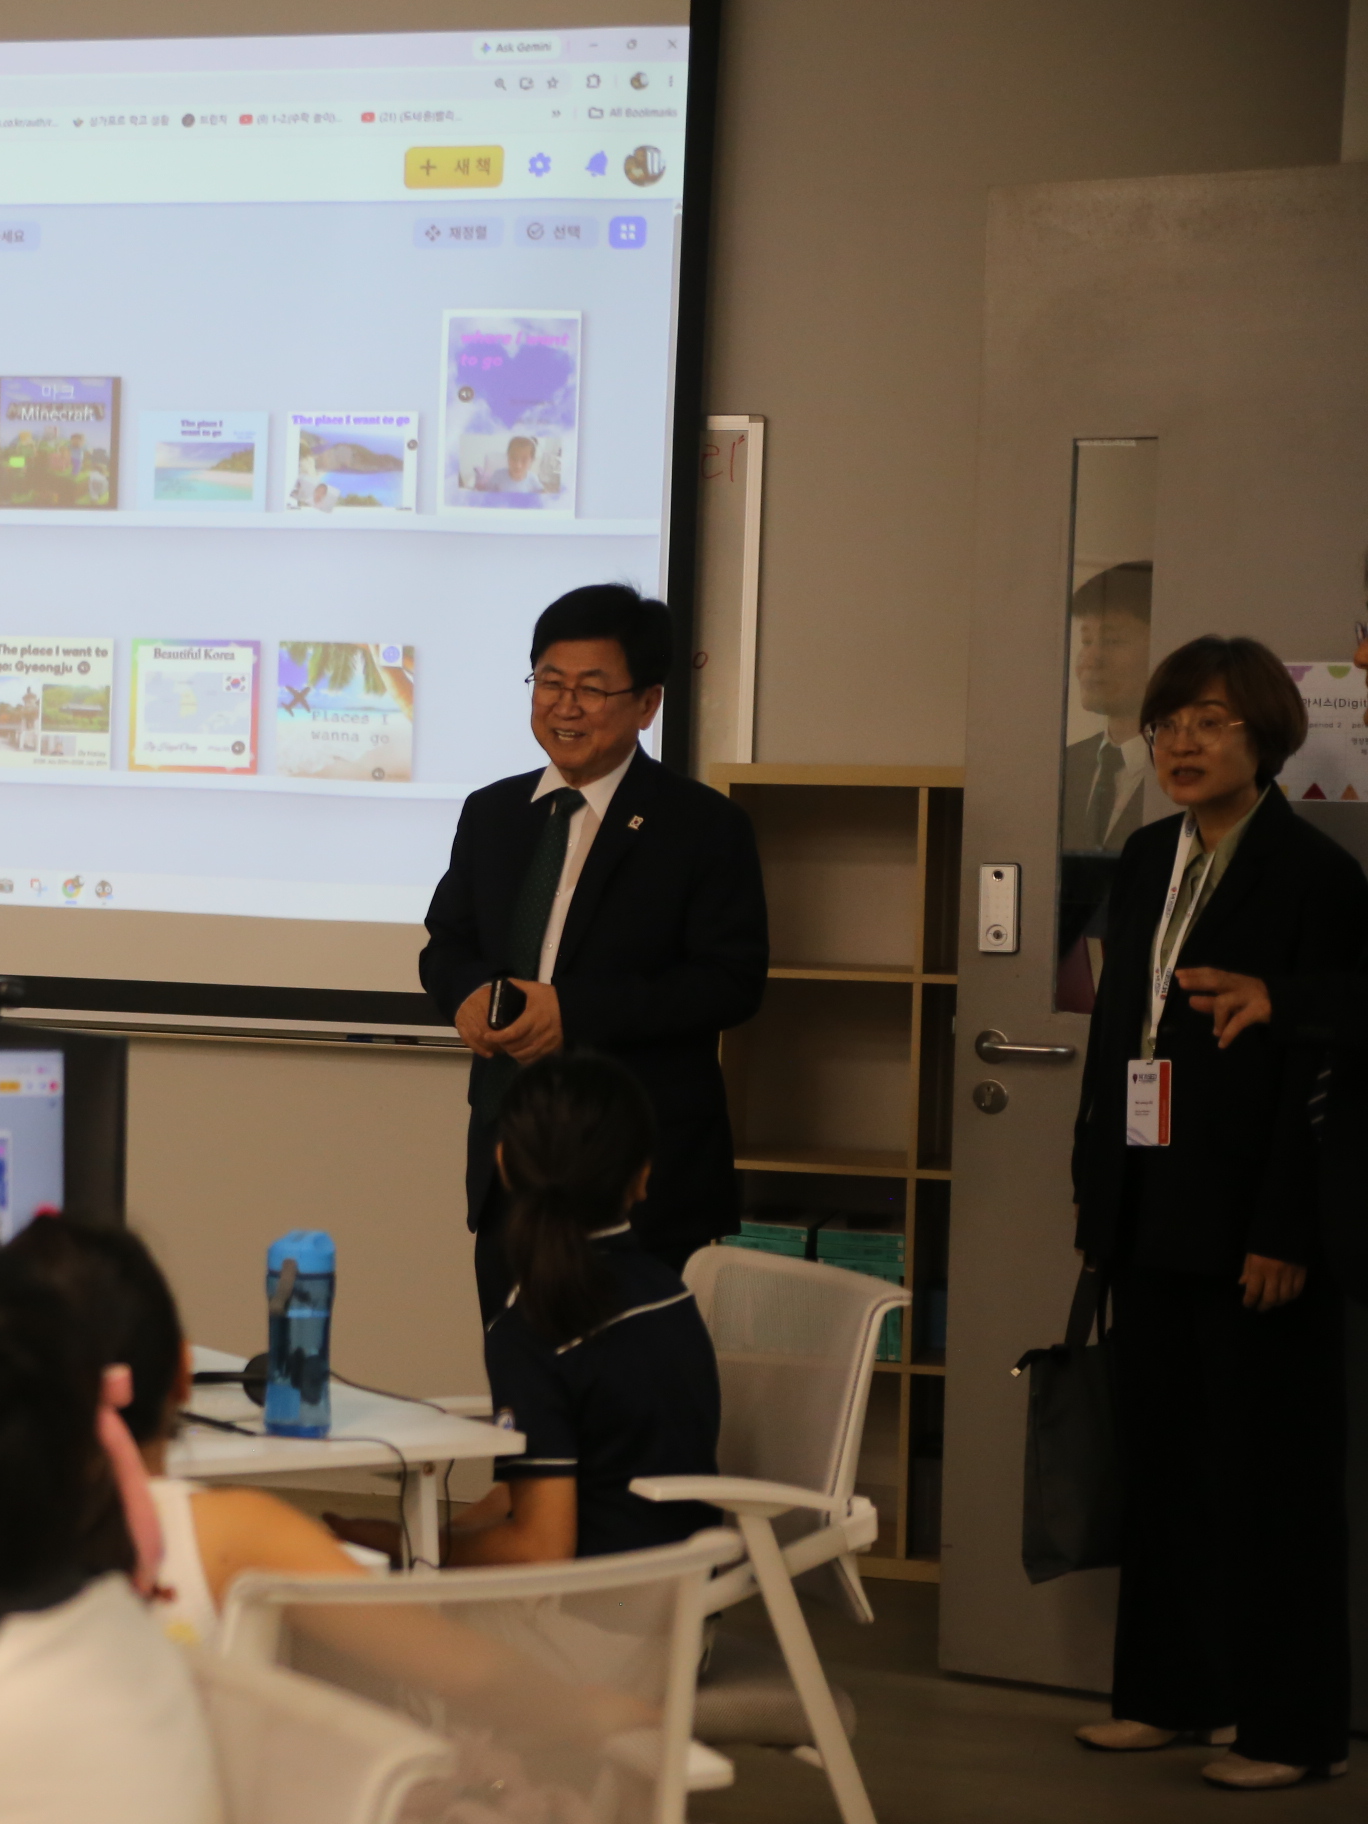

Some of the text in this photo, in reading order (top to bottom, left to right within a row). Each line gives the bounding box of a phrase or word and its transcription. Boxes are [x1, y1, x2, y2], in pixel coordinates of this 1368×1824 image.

[496, 41, 552, 53] Ask Gemini
[625, 106, 678, 119] Bookmarks
[454, 156, 492, 177] 새 책
[449, 223, 489, 242] 재정렬
[553, 223, 582, 241] 선택
[460, 352, 504, 372] to go
[20, 405, 95, 422] Minecraft
[291, 414, 314, 426] The
[314, 414, 345, 427] place
[352, 415, 381, 426] want
[381, 415, 395, 426] to
[395, 416, 411, 428] go
[19, 644, 54, 659] place
[55, 645, 60, 657] I
[61, 645, 92, 658] want
[94, 646, 109, 658] to
[153, 646, 236, 662] Beautiful Korea
[14, 659, 73, 676] Gyeongju
[311, 709, 389, 726] Places I
[310, 730, 391, 748] wanna go
